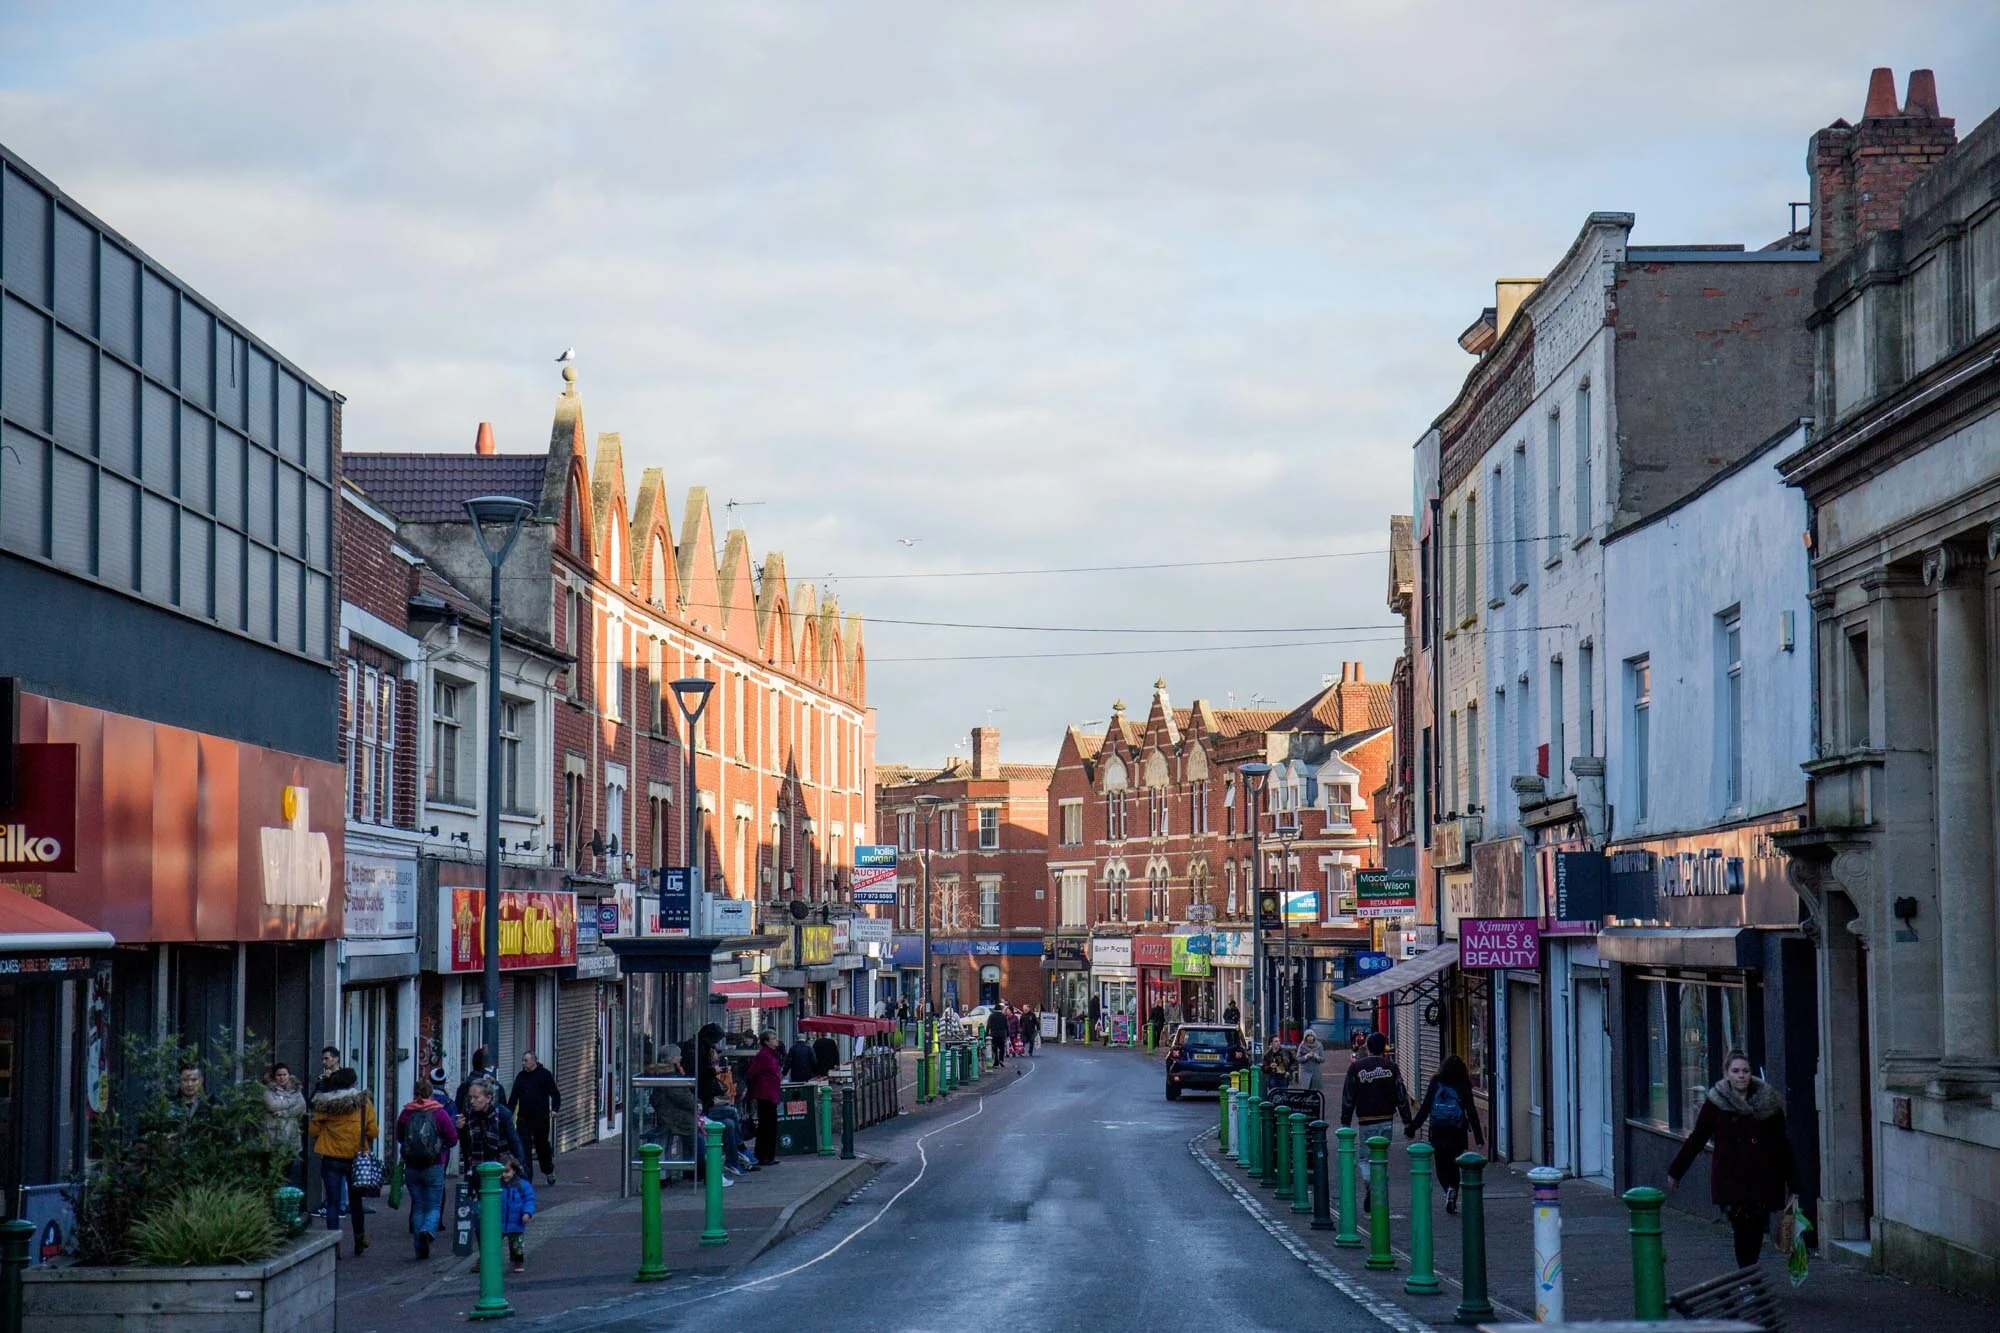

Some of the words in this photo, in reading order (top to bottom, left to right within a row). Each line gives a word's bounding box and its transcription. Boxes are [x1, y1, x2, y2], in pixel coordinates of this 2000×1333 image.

[874, 847, 894, 856] hollis
[861, 855, 894, 864] morgan
[1383, 881, 1410, 890] Wilson
[524, 905, 555, 955] Slots
[1476, 921, 1525, 934] Kimmy's
[1465, 934, 1518, 949] NAILS
[1522, 934, 1535, 949] &
[1465, 950, 1537, 966] BEAUTY
